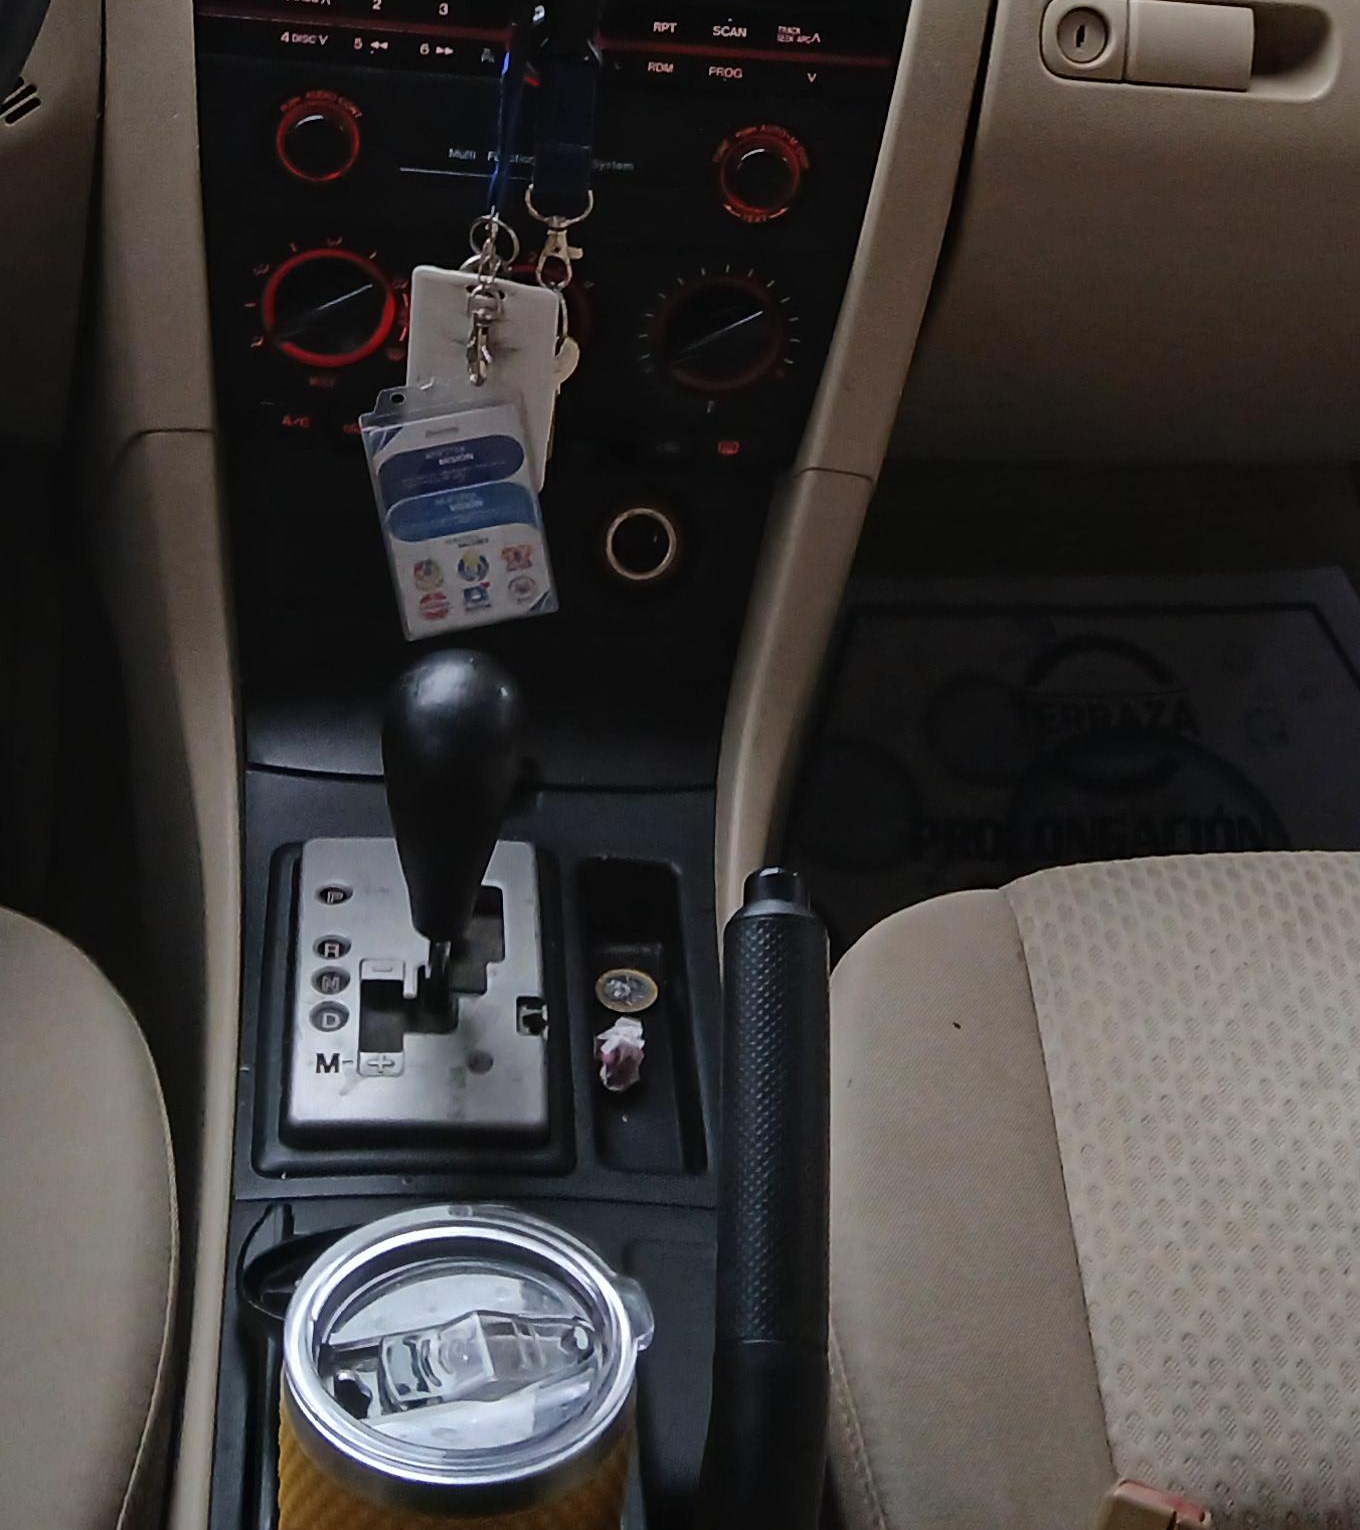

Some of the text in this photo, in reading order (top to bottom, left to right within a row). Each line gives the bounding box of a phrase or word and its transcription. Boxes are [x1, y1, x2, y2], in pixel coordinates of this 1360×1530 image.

[438, 2, 449, 16] 3
[653, 21, 678, 34] RPT
[712, 25, 748, 38] SCAN
[280, 31, 290, 44] 4
[353, 38, 363, 50] 5
[419, 43, 430, 56] 6
[647, 61, 674, 74] RDM
[708, 66, 744, 79] PROG
[322, 976, 340, 992] N
[322, 1012, 339, 1028] D
[315, 1053, 341, 1074] M
